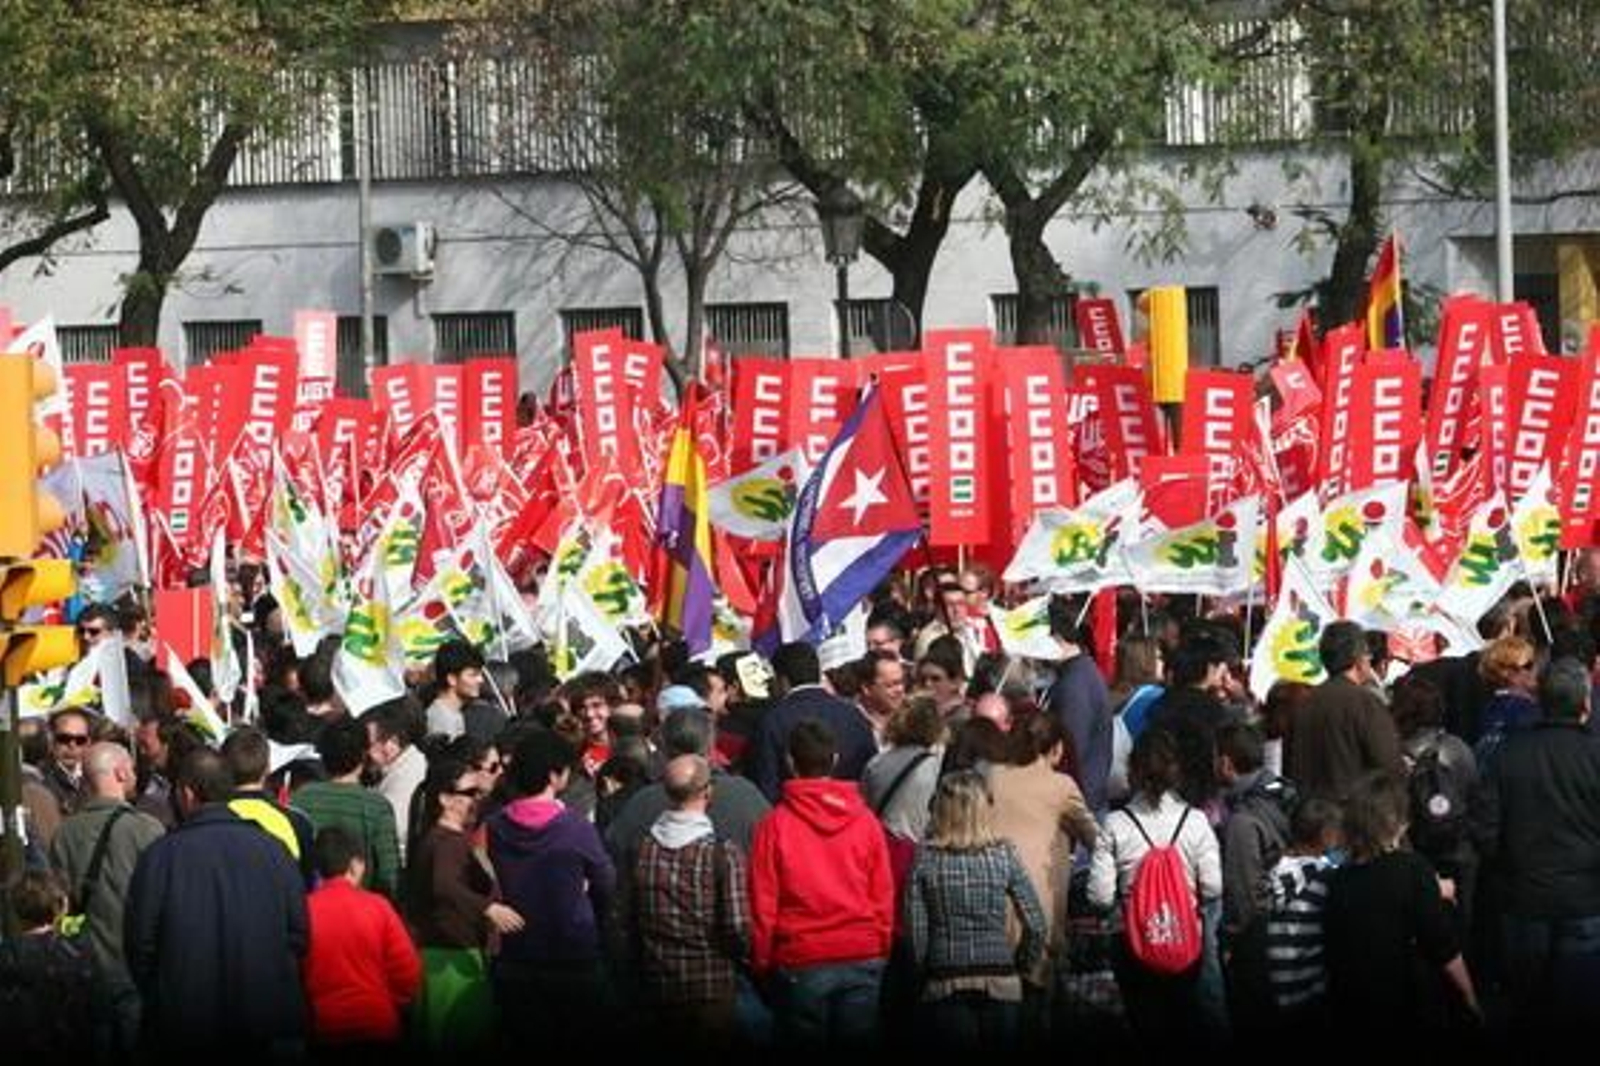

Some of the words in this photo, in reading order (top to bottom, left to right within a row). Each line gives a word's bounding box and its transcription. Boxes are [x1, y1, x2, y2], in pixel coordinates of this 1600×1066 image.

[947, 343, 974, 470] CCOO
[1027, 376, 1057, 503] CCOO
[1439, 324, 1478, 446] CCOO
